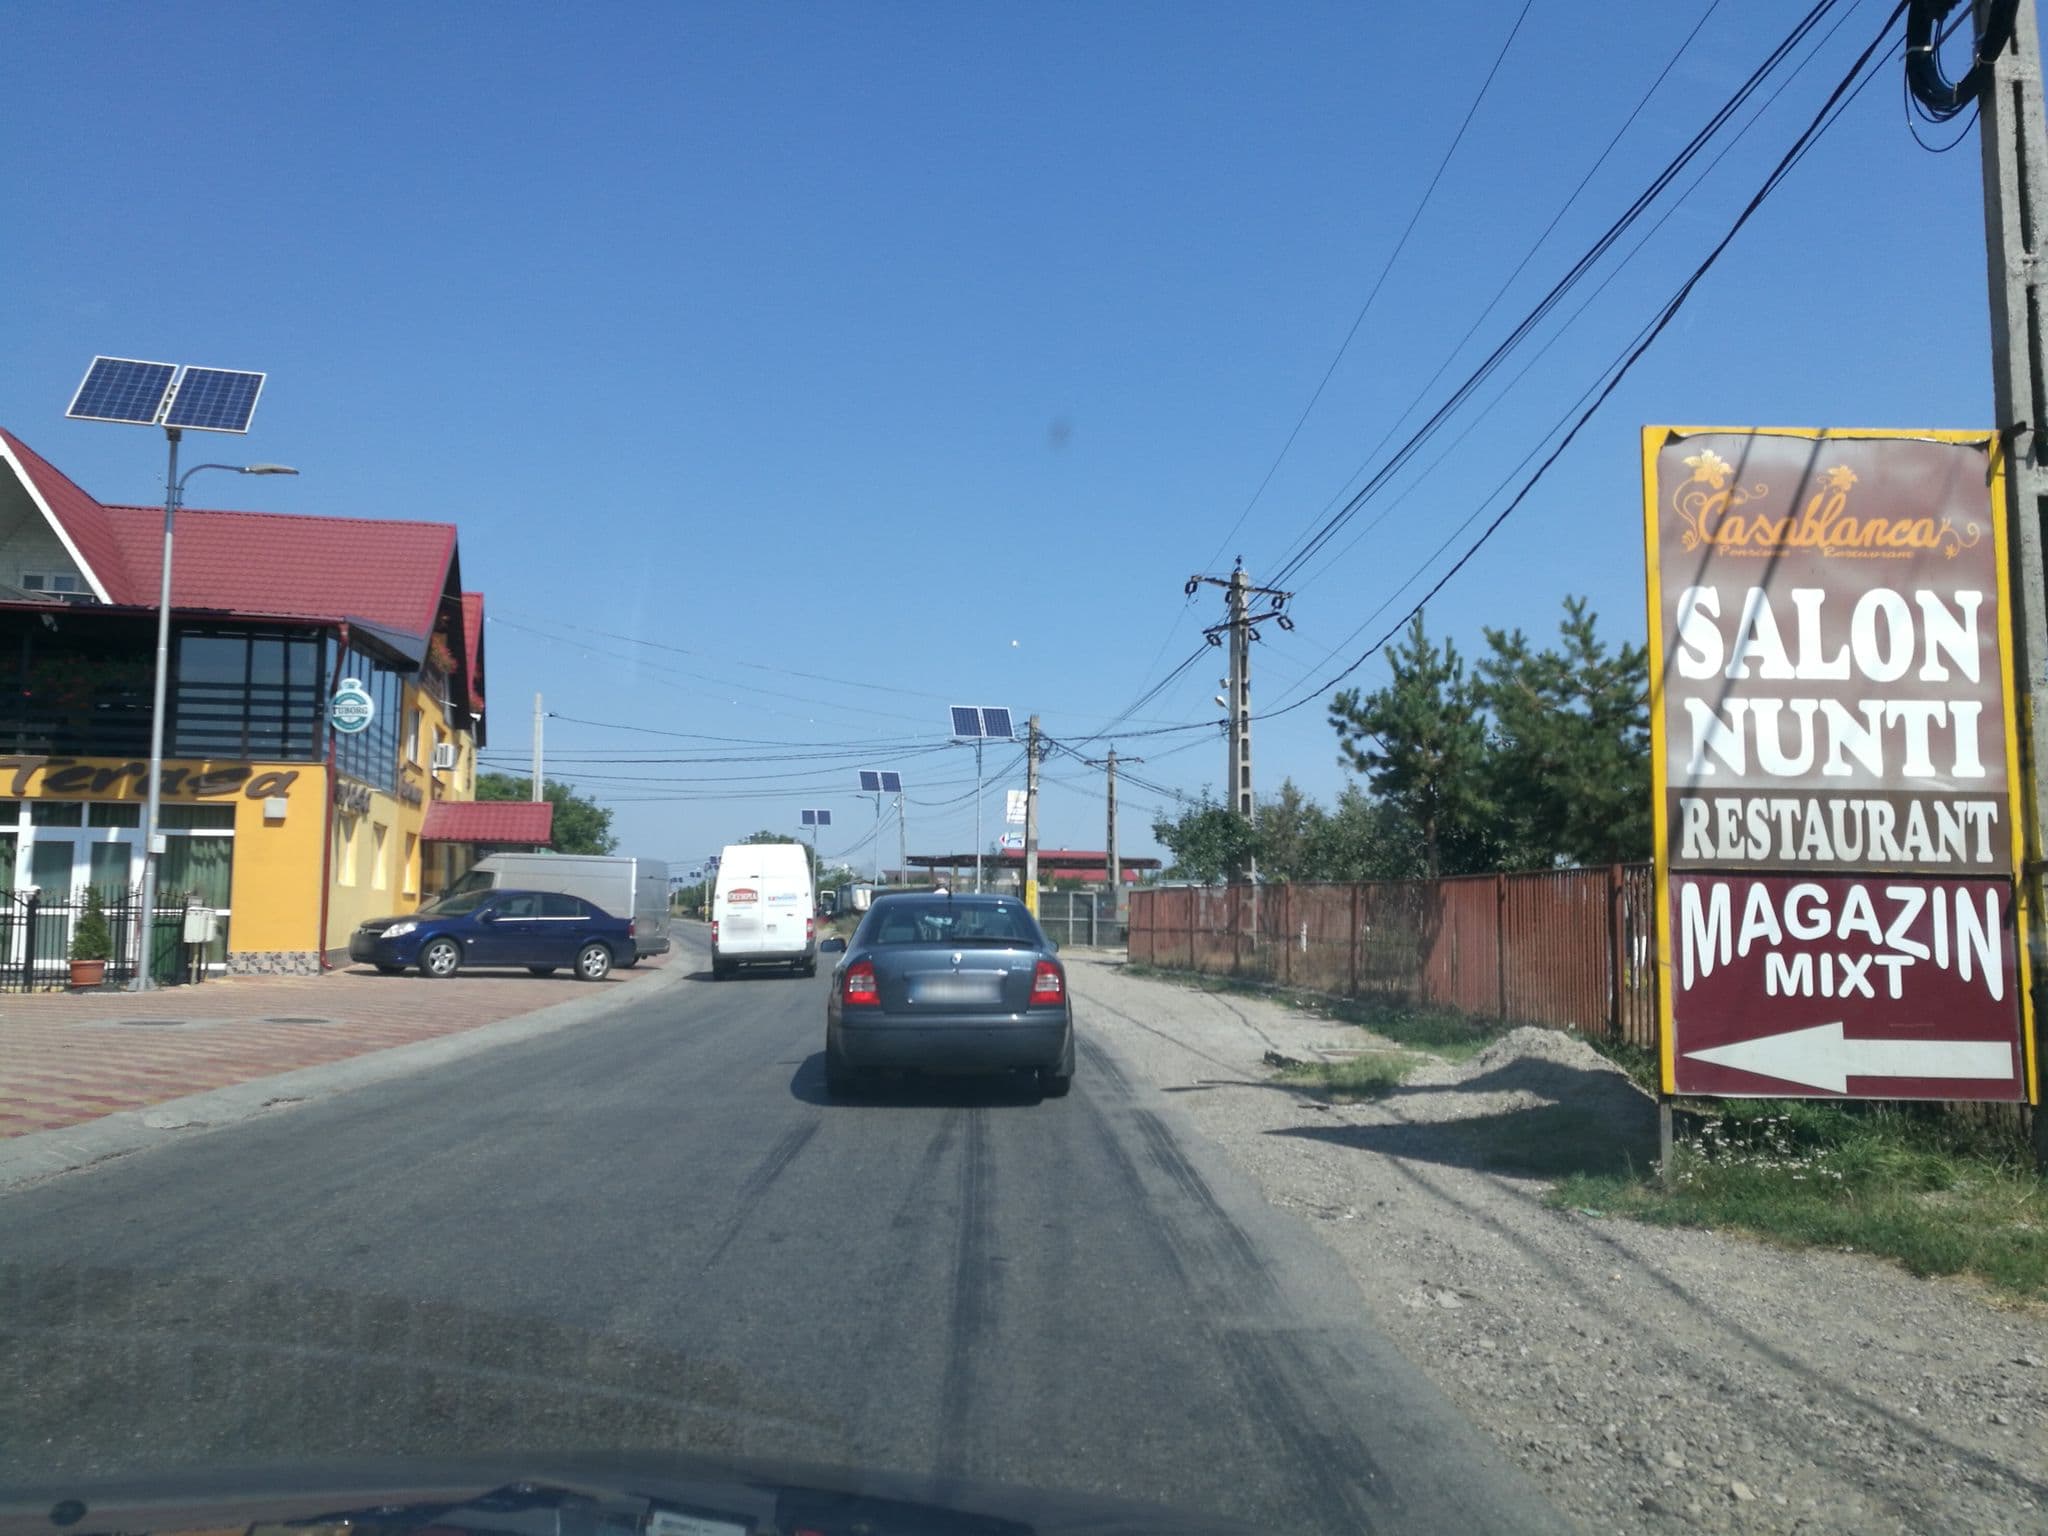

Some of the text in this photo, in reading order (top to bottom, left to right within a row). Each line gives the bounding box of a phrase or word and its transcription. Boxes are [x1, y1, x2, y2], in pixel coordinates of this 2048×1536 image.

[1699, 489, 1942, 548] Casablanca
[1677, 586, 1982, 684] SALON
[332, 705, 368, 715] TUBORG
[1683, 698, 1987, 779] NUNTI
[0, 756, 299, 799] Terasa
[1680, 797, 1998, 864] RESTAURANT
[1681, 882, 2004, 1002] MAGAZIN
[1765, 953, 1915, 999] MIXT
